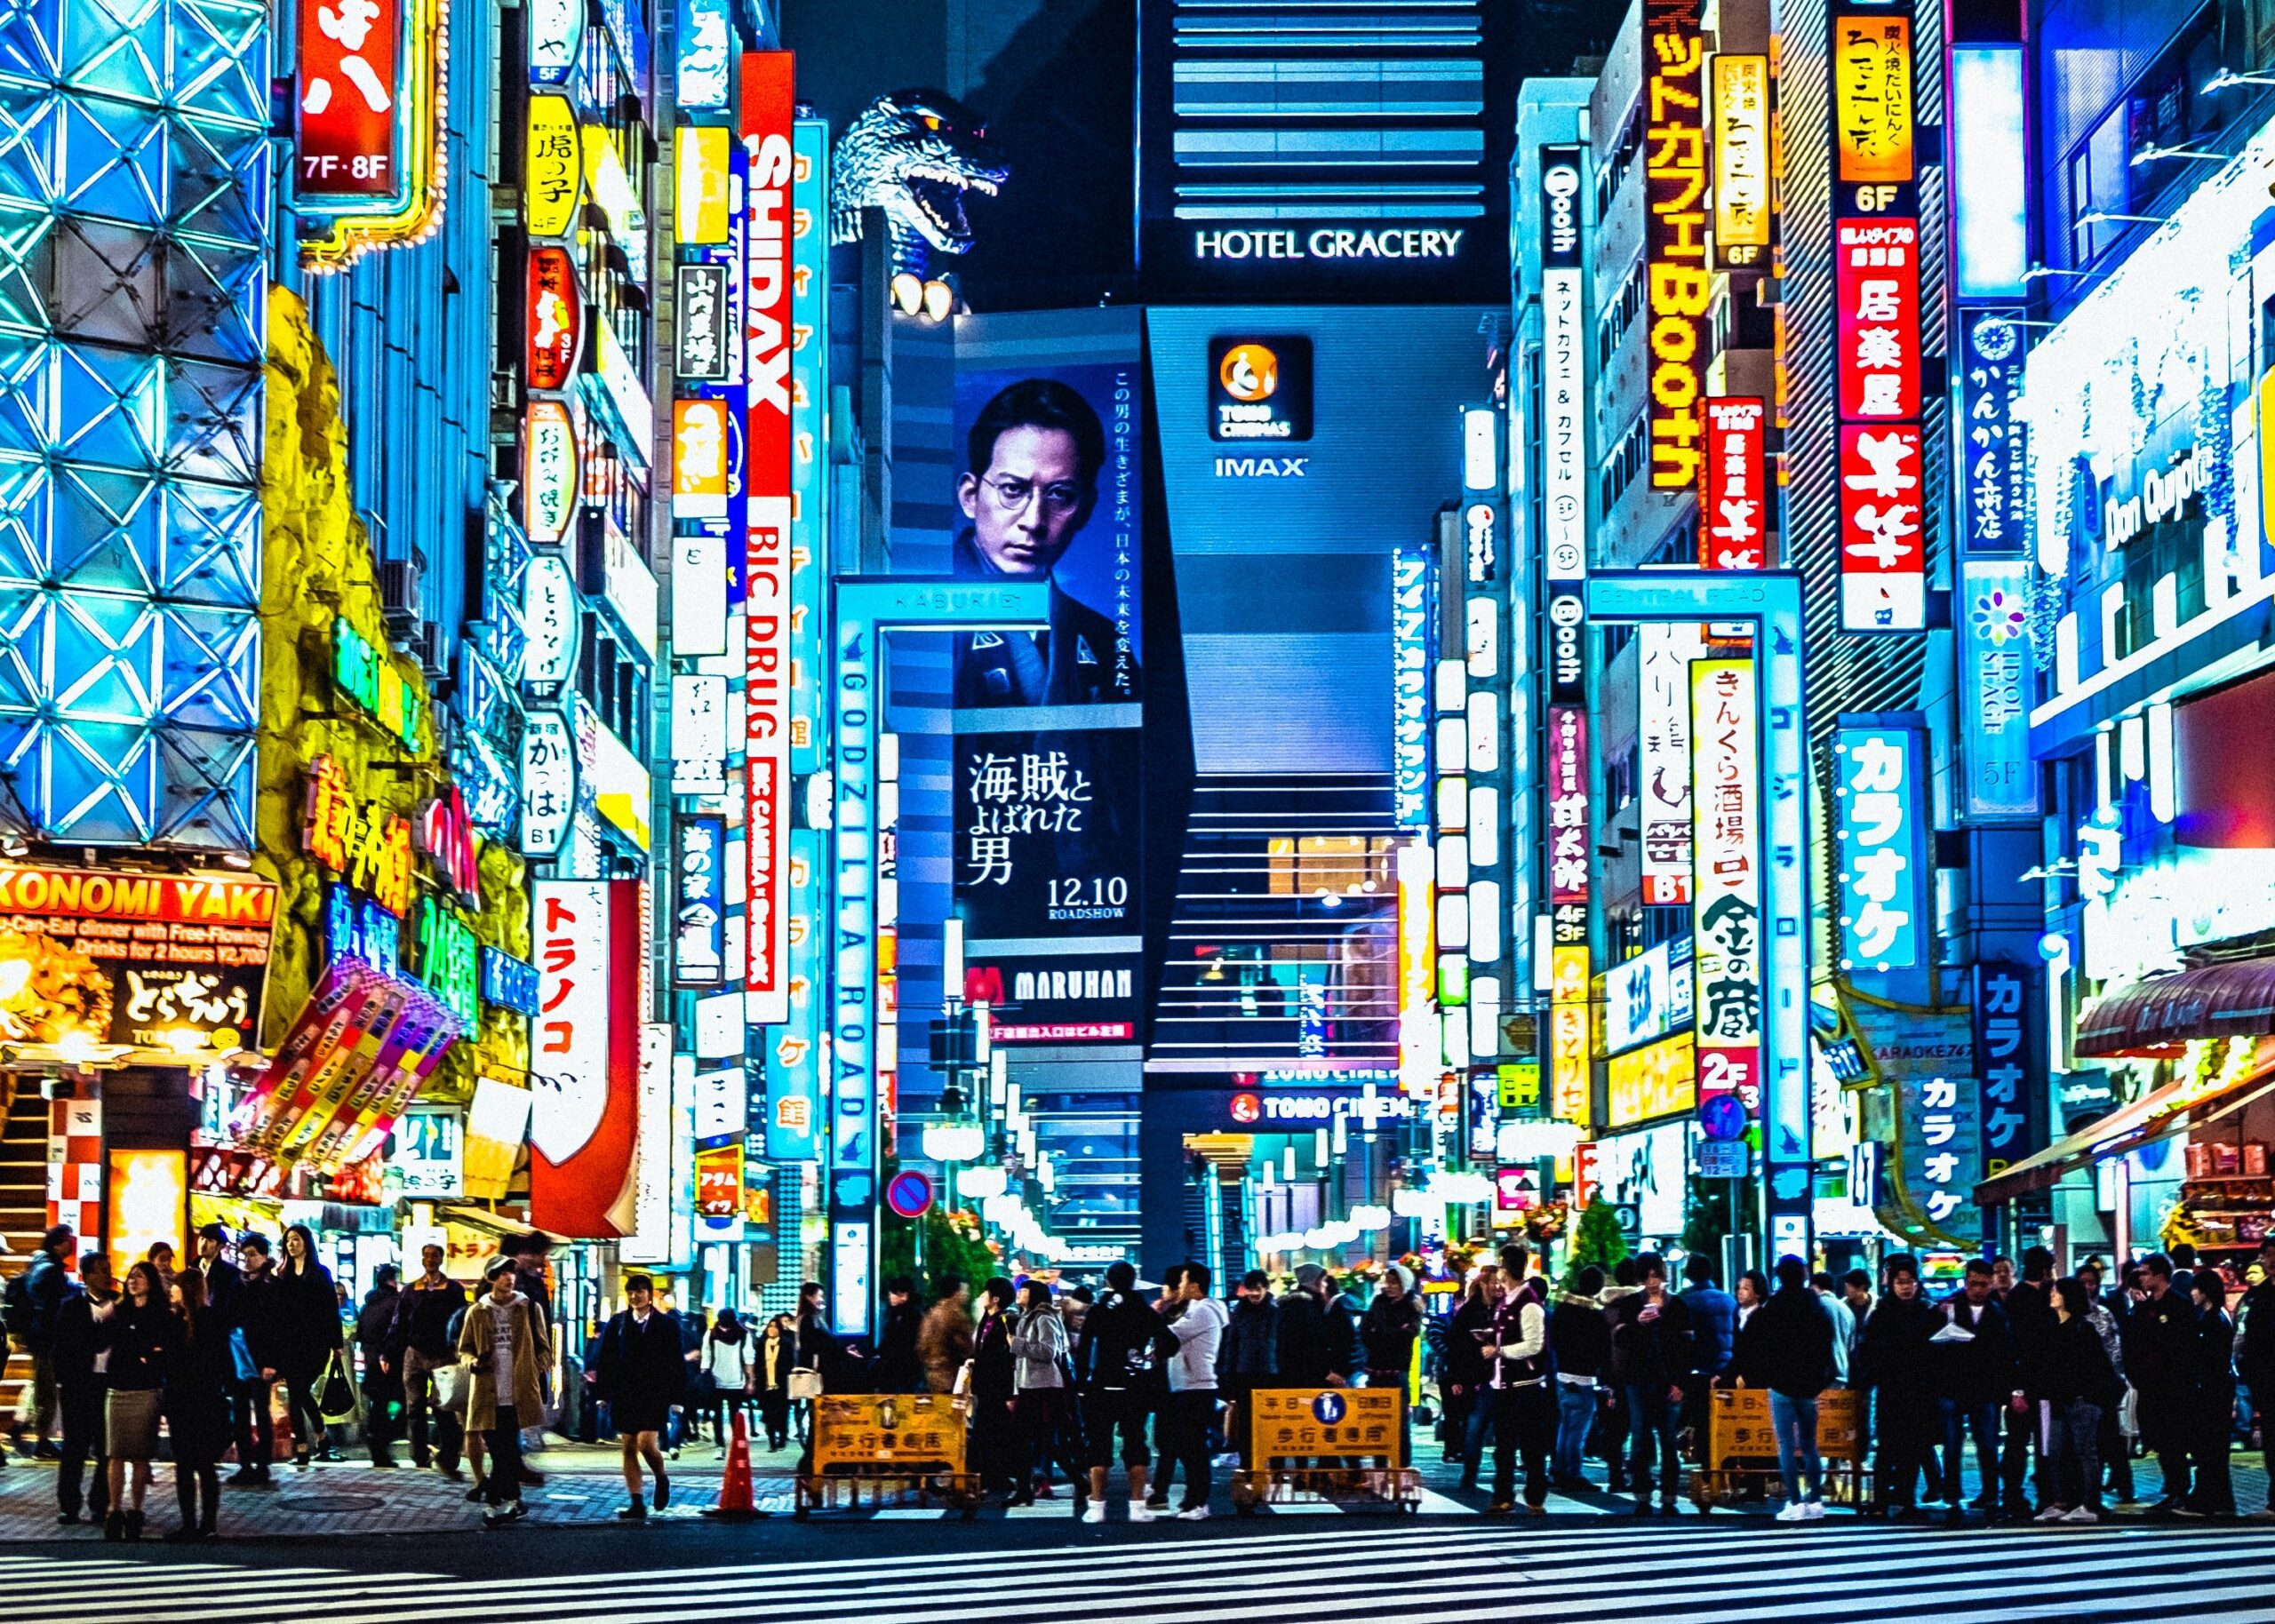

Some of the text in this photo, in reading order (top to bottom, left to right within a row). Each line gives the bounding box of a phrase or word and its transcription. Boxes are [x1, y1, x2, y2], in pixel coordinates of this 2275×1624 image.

[539, 68, 561, 81] 5F
[536, 134, 572, 203] 虎の子
[1855, 185, 1898, 212] 6F
[1195, 229, 1464, 259] HOTEL GRACERY
[1728, 246, 1759, 265] 6F
[743, 133, 792, 416] SHIDAX
[1856, 280, 1904, 415] 居楽屋
[1215, 458, 1309, 477] IMAX
[2105, 495, 2141, 553] Don
[746, 526, 779, 740] BIC DRUG
[1550, 594, 1584, 683] Booth
[531, 681, 557, 697] 1F
[2002, 652, 2021, 716] IDOL
[969, 751, 1093, 804] 海賊と
[1714, 671, 1744, 845] きんくら酒場
[1984, 760, 2021, 785] 5F
[531, 829, 556, 845] B1
[968, 802, 1082, 835] よばれた
[968, 836, 1014, 886] 男
[1850, 736, 1909, 960] カラオケ
[176, 880, 275, 922] YAKI
[839, 672, 867, 1118] GODZILLA ROAD
[1047, 876, 1129, 906] 12.10
[1049, 908, 1126, 920] ROADSHOW
[1555, 904, 1586, 923] 4F
[1555, 923, 1586, 942] 3F
[76, 939, 126, 959] Drinks
[129, 941, 154, 959] for
[155, 943, 166, 960] 2
[169, 943, 214, 963] hours
[78, 919, 132, 939] dinner
[133, 922, 167, 941] with
[171, 924, 269, 949] Free-Flowing
[542, 897, 576, 1054] トラノコ
[1015, 969, 1132, 1000] MARUHAN
[1702, 894, 1760, 1039] 金の蔵
[1702, 1052, 1748, 1090] 2F
[1984, 974, 2025, 1149] カラオケ
[1921, 1077, 1962, 1222] カラオケ
